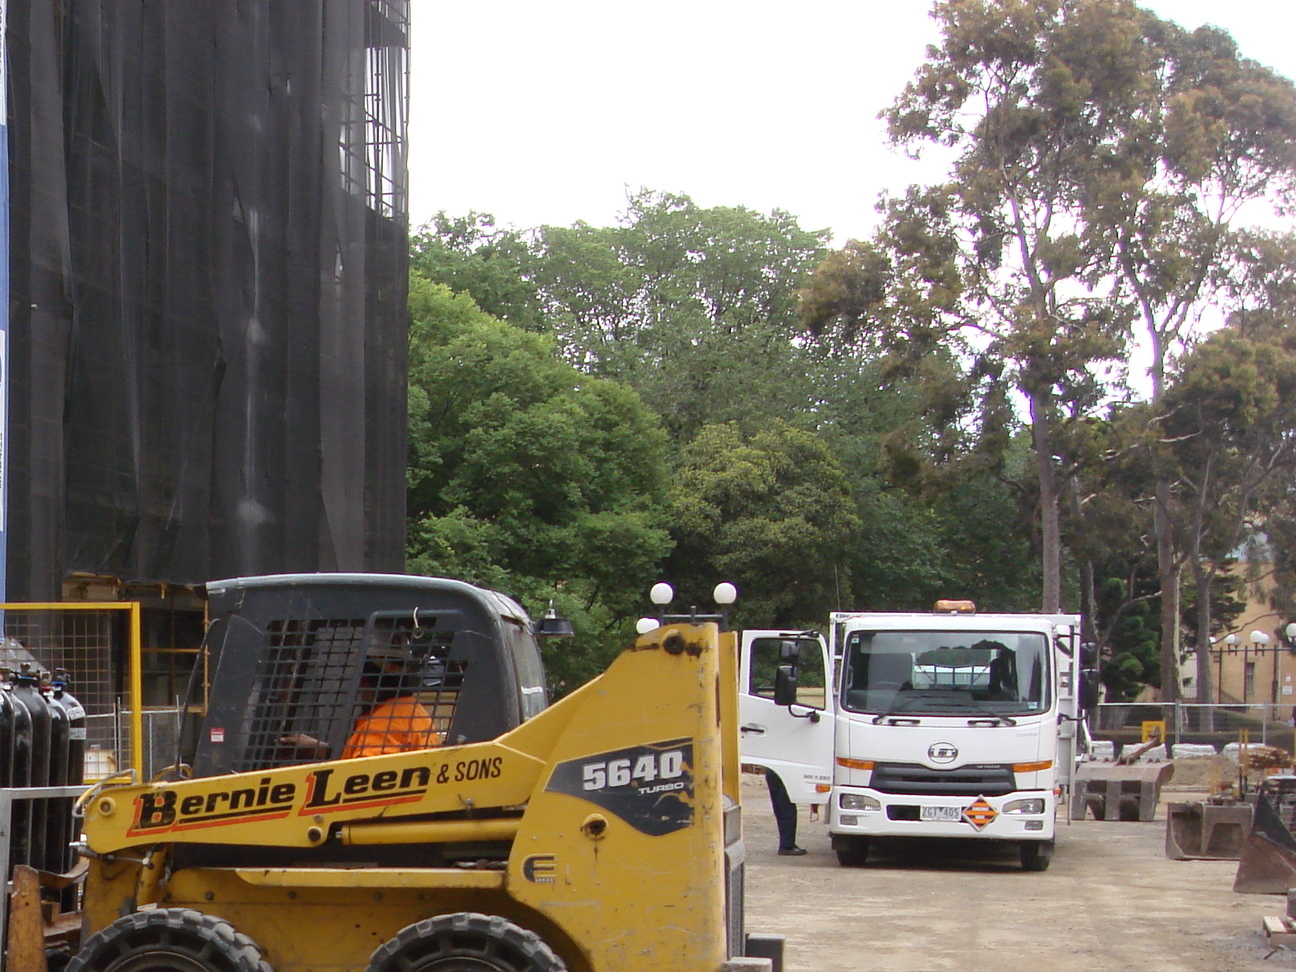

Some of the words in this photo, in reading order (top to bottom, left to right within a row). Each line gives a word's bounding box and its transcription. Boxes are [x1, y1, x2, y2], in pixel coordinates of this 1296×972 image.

[583, 750, 683, 791] 5640
[638, 781, 685, 795] TURBO
[136, 777, 295, 832] Bernie
[304, 764, 431, 809] Leen
[435, 762, 449, 785] &
[453, 756, 503, 782] SONS
